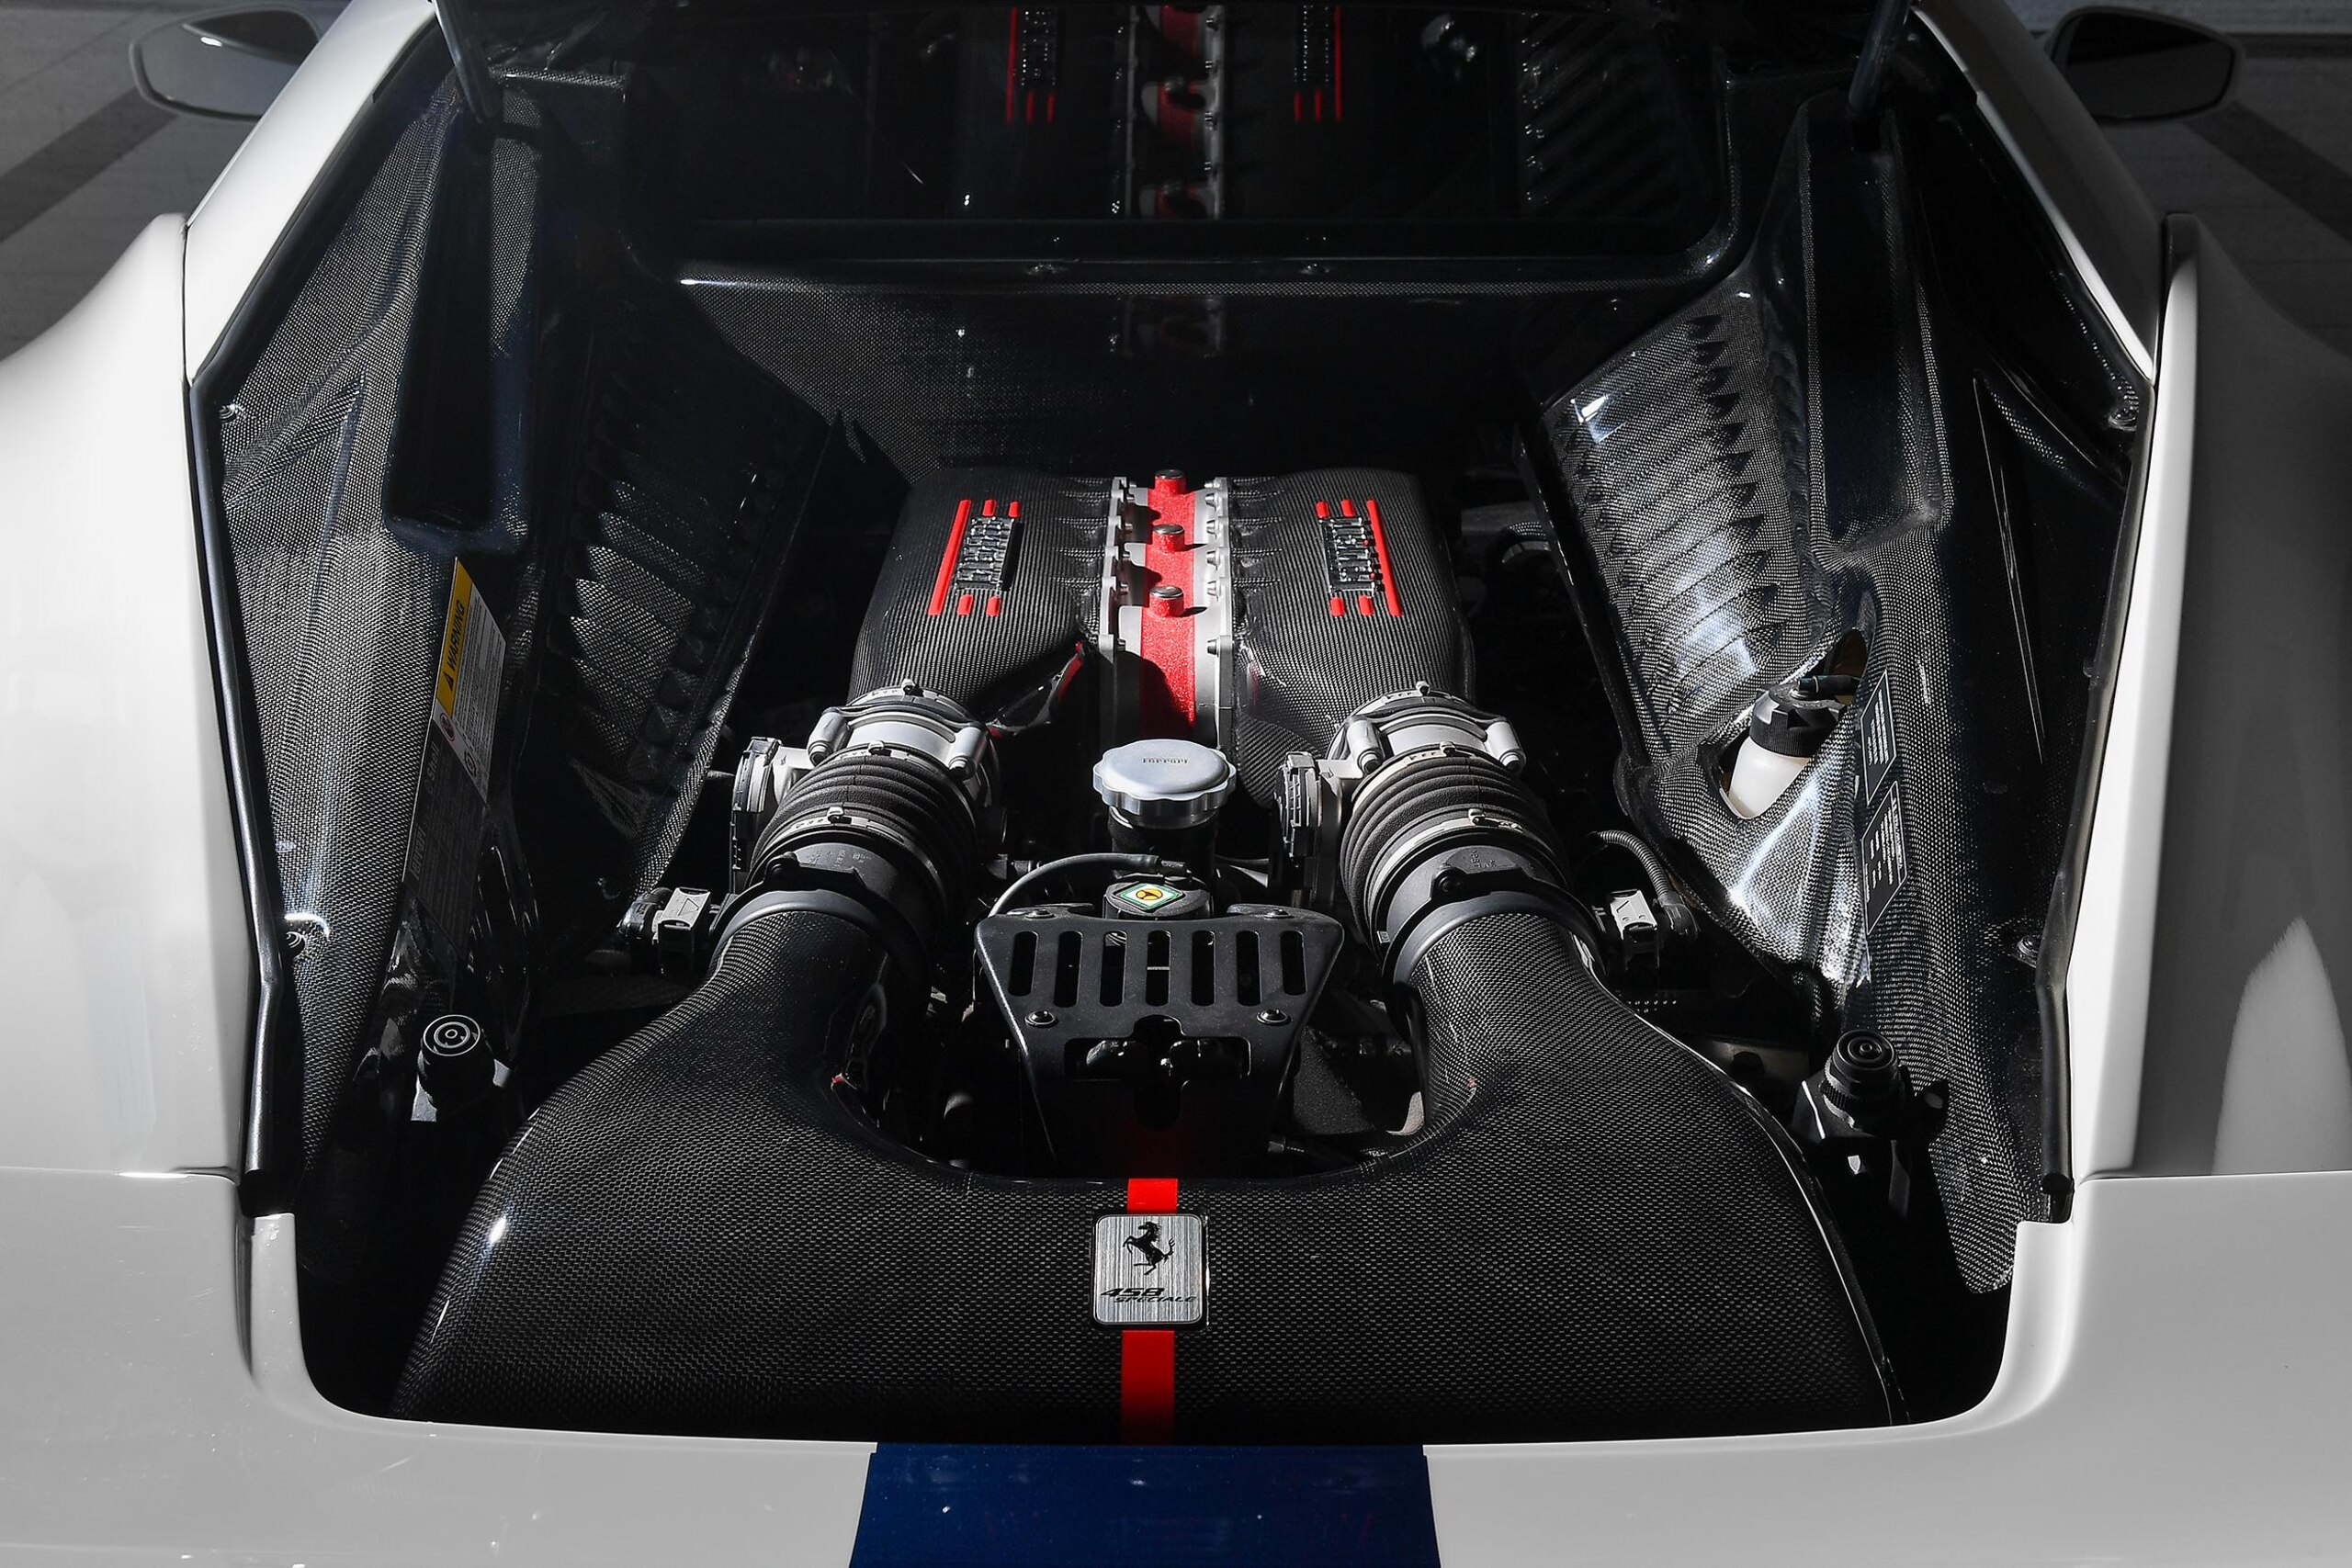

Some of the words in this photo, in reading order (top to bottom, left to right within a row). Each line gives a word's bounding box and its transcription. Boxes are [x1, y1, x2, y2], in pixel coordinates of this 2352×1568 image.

[447, 600, 465, 671] WARNING
[426, 741, 440, 781] Shell
[1100, 1288, 1165, 1297] 458
